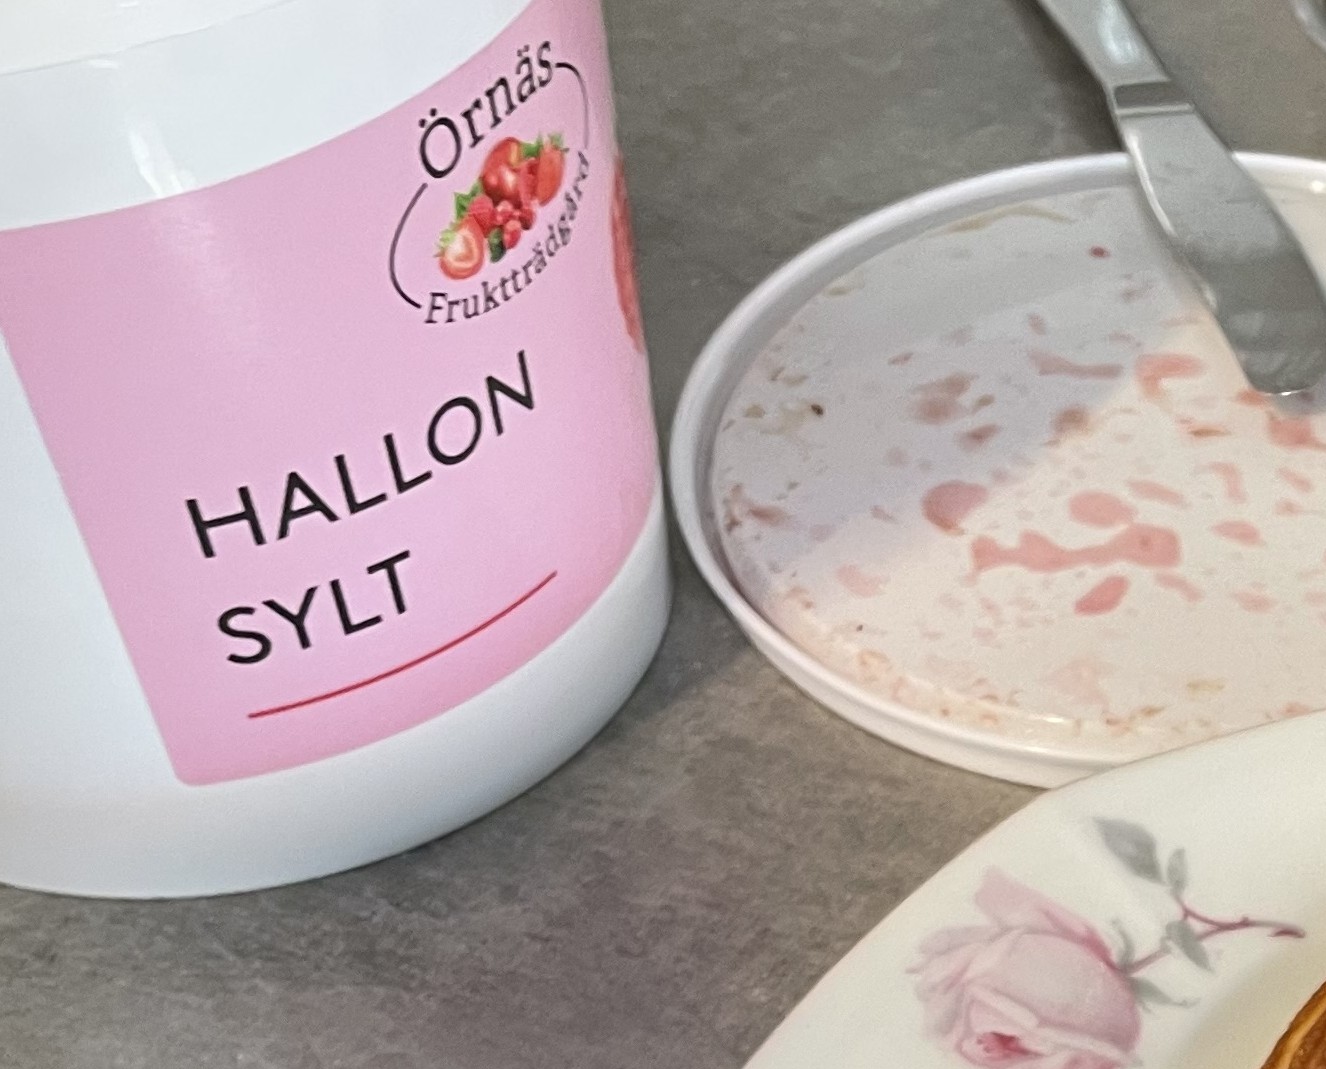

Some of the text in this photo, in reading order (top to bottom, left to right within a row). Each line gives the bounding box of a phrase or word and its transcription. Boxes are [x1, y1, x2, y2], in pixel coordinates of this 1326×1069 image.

[418, 40, 555, 179] Örnäs
[423, 151, 590, 324] Fruktträdgård
[186, 350, 535, 558] HALLON
[217, 550, 410, 664] SYLT
